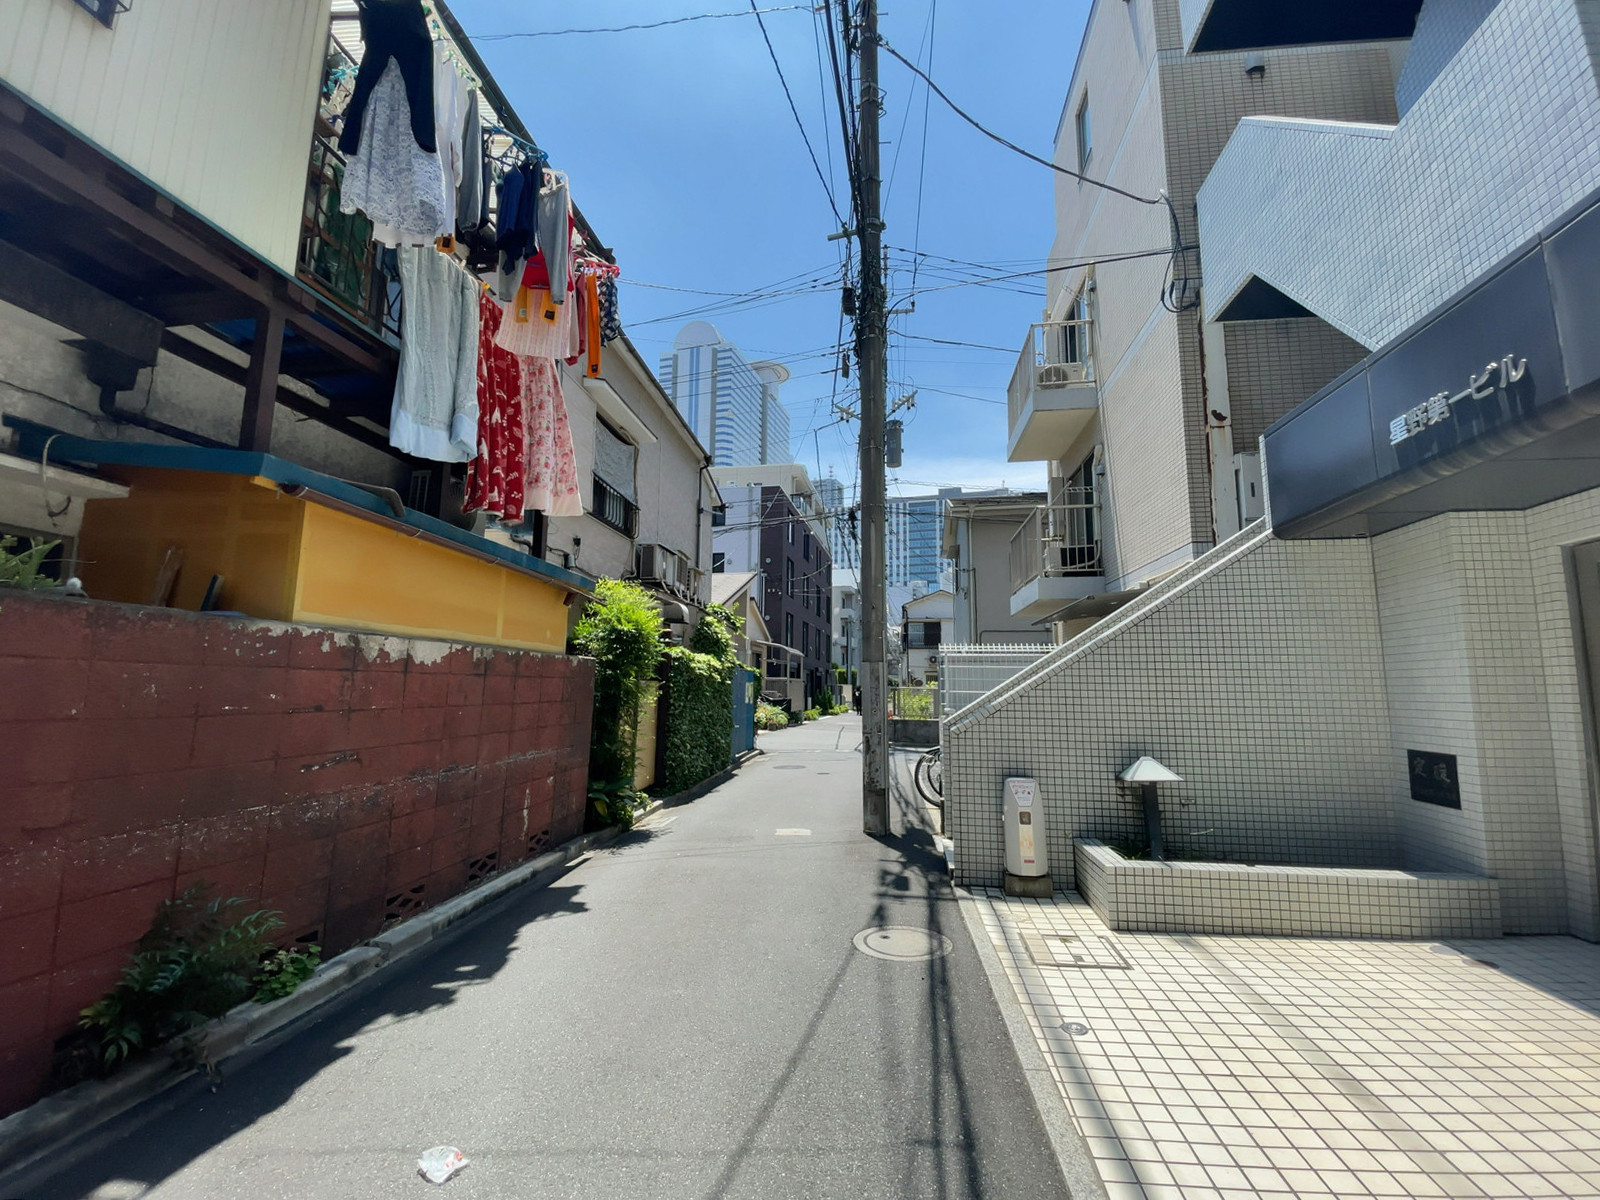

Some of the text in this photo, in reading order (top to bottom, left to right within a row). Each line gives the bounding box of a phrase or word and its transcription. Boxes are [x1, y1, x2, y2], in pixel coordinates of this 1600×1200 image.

[1389, 353, 1528, 446] 星野第一ビル
